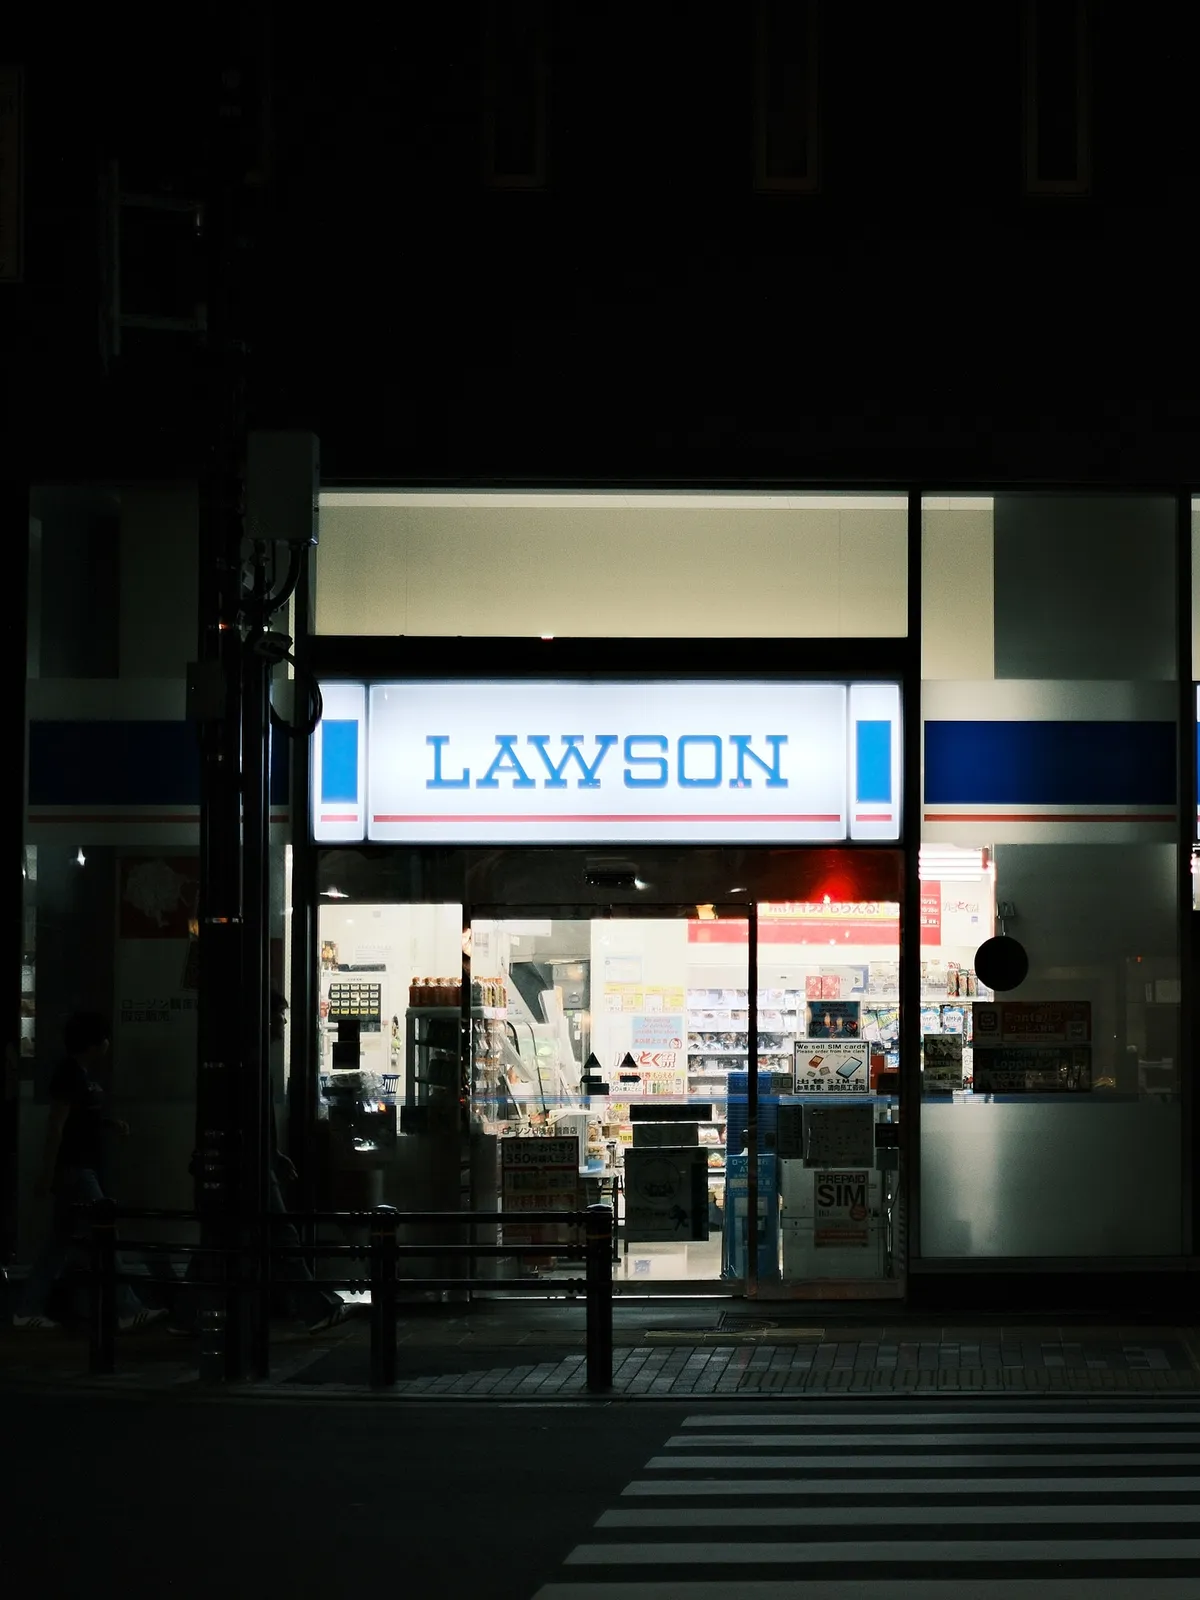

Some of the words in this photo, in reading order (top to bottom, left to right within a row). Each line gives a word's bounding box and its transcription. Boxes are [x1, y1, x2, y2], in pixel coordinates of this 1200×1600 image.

[426, 734, 789, 789] LAWSON
[818, 1174, 866, 1184] PREPAID
[817, 1185, 866, 1208] SIM
